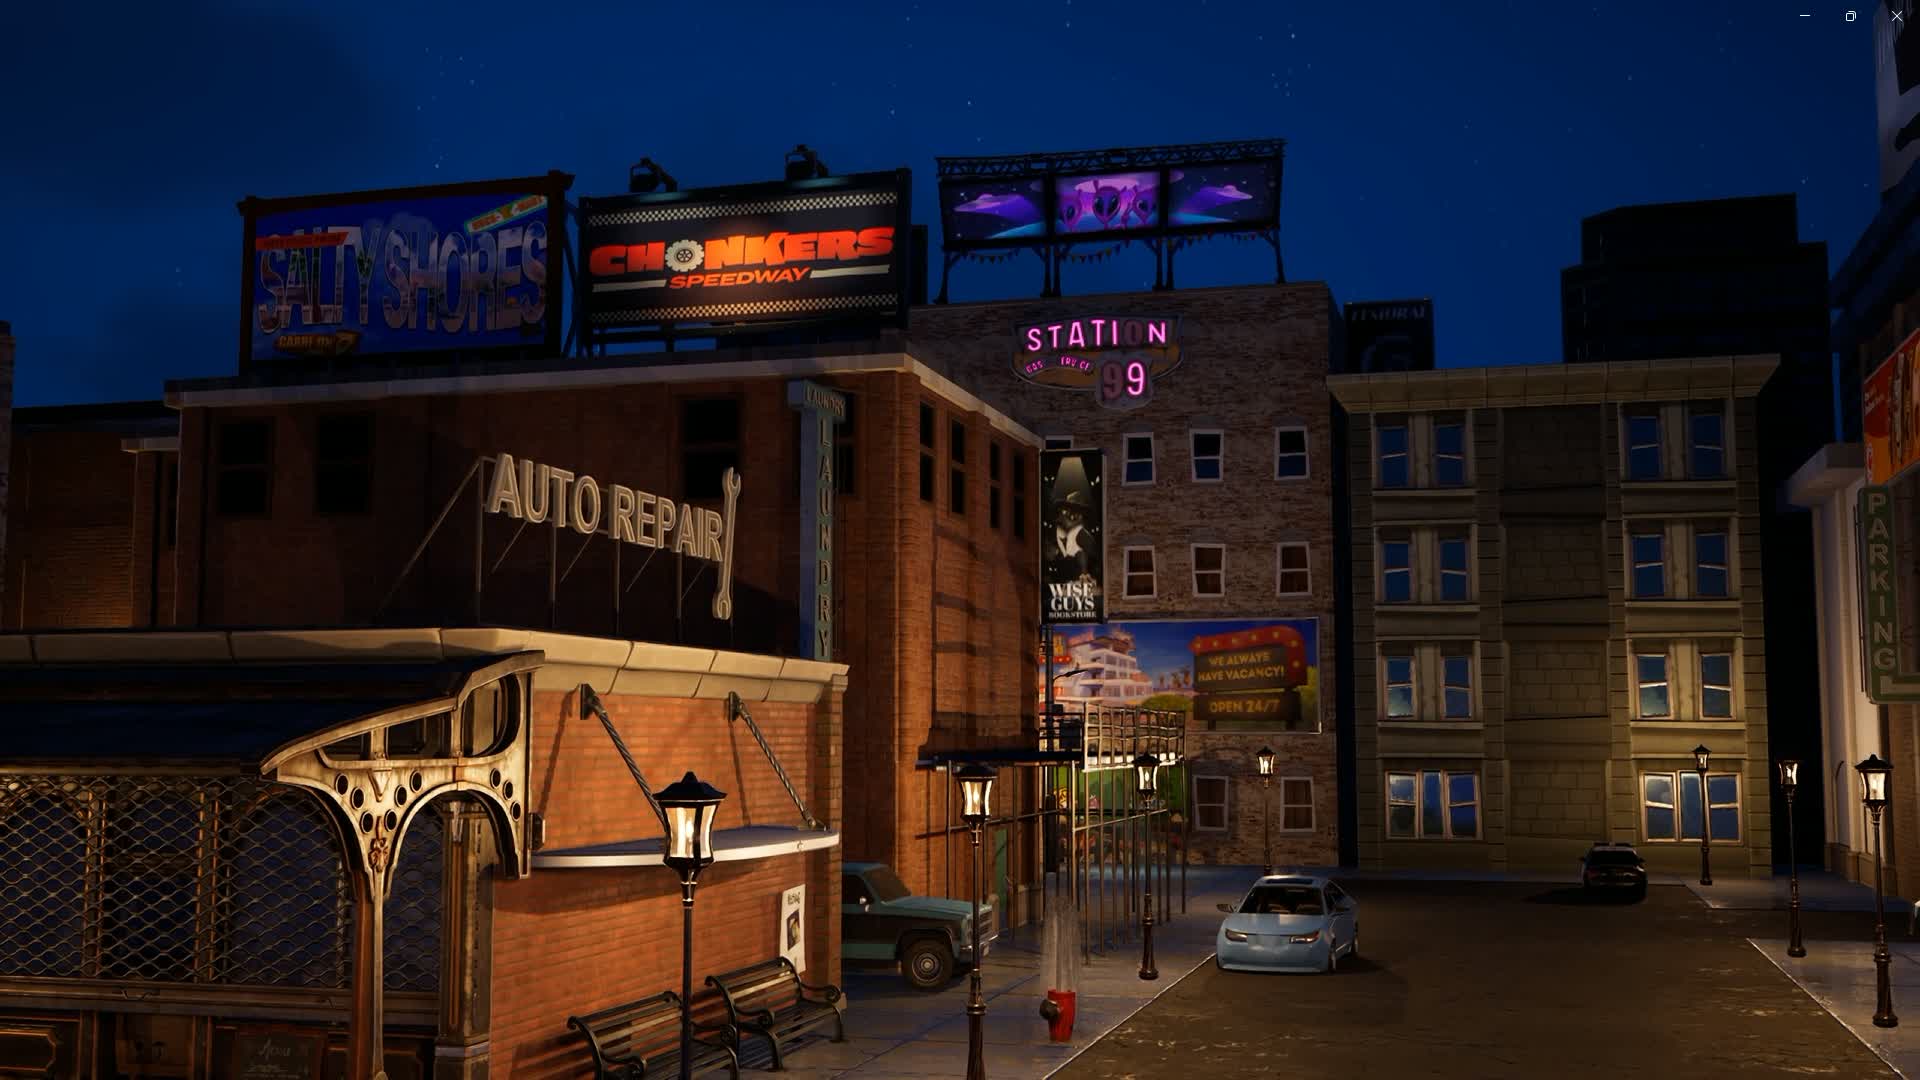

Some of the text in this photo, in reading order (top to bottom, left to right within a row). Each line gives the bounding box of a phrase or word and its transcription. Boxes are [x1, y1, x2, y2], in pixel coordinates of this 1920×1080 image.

[588, 226, 897, 277] CHONKERS
[668, 266, 811, 289] SPEEDWAY
[1026, 319, 1167, 351] STATION
[1102, 360, 1147, 400] 99
[486, 452, 724, 563] AUTO REPAIR
[818, 417, 833, 657] LAUNDRY
[1048, 582, 1097, 597] WISE
[1867, 492, 1897, 671] PARKING
[1050, 596, 1095, 611] GUYS
[1198, 665, 1285, 682] HAVE VACANCY!
[1208, 656, 1224, 666] WE
[1209, 698, 1280, 713] OPEN 24/7
